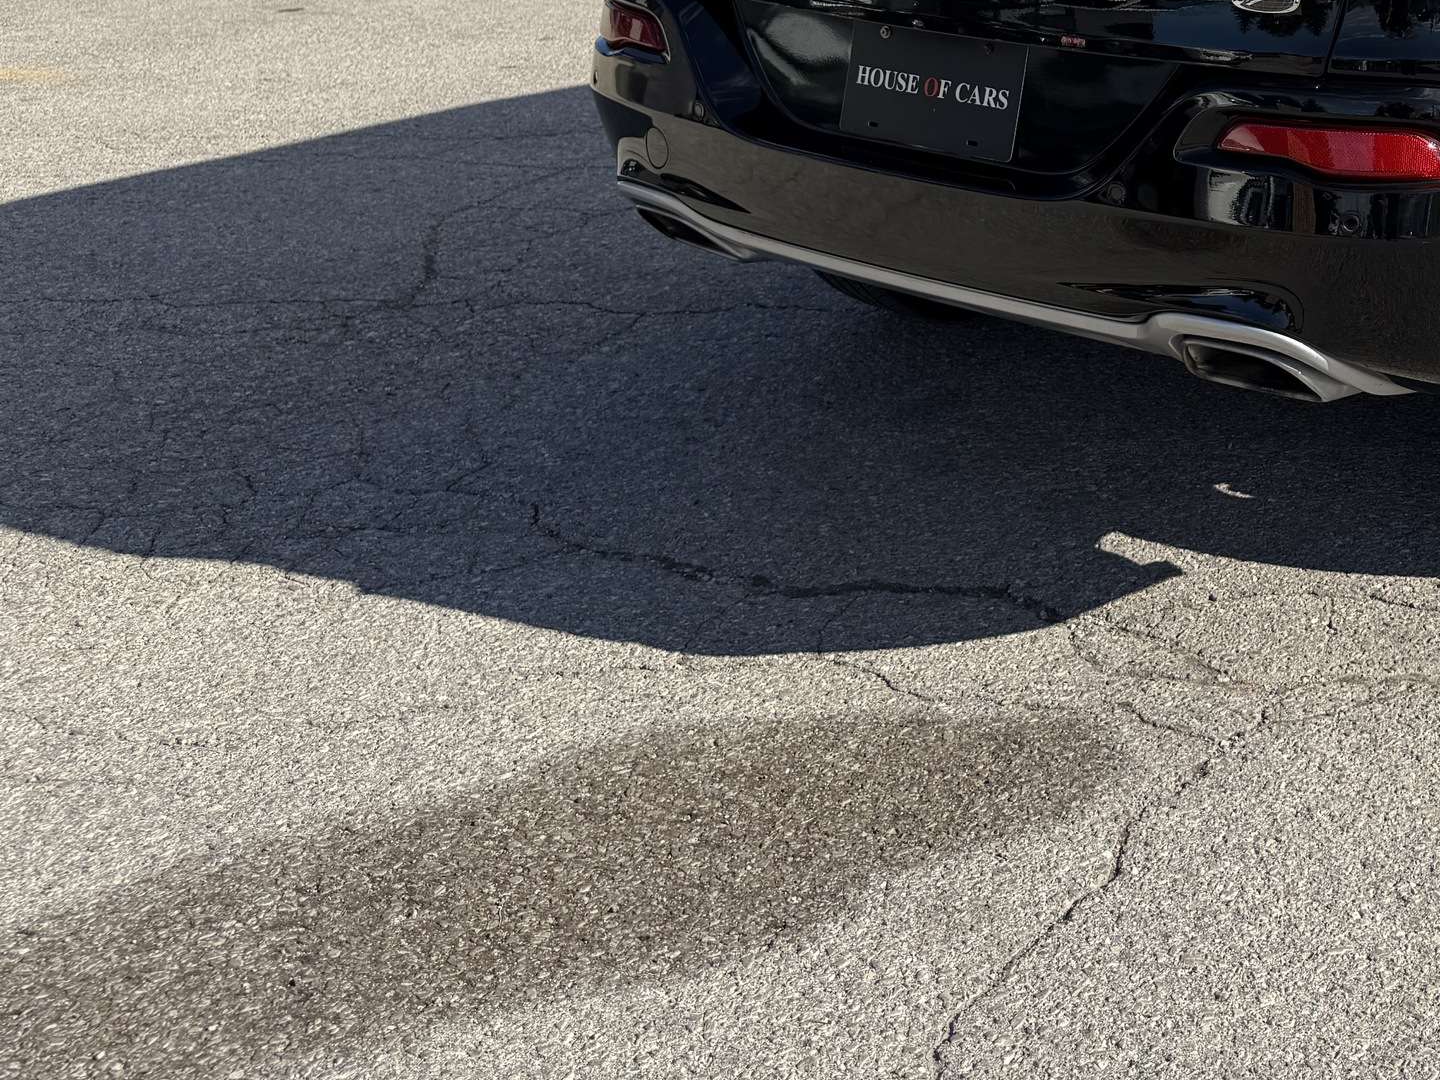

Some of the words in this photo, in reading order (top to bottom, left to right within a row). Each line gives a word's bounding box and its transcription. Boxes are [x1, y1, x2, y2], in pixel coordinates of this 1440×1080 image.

[855, 64, 921, 95] HOUSE
[923, 76, 952, 100] OF
[955, 82, 1010, 111] CARS
